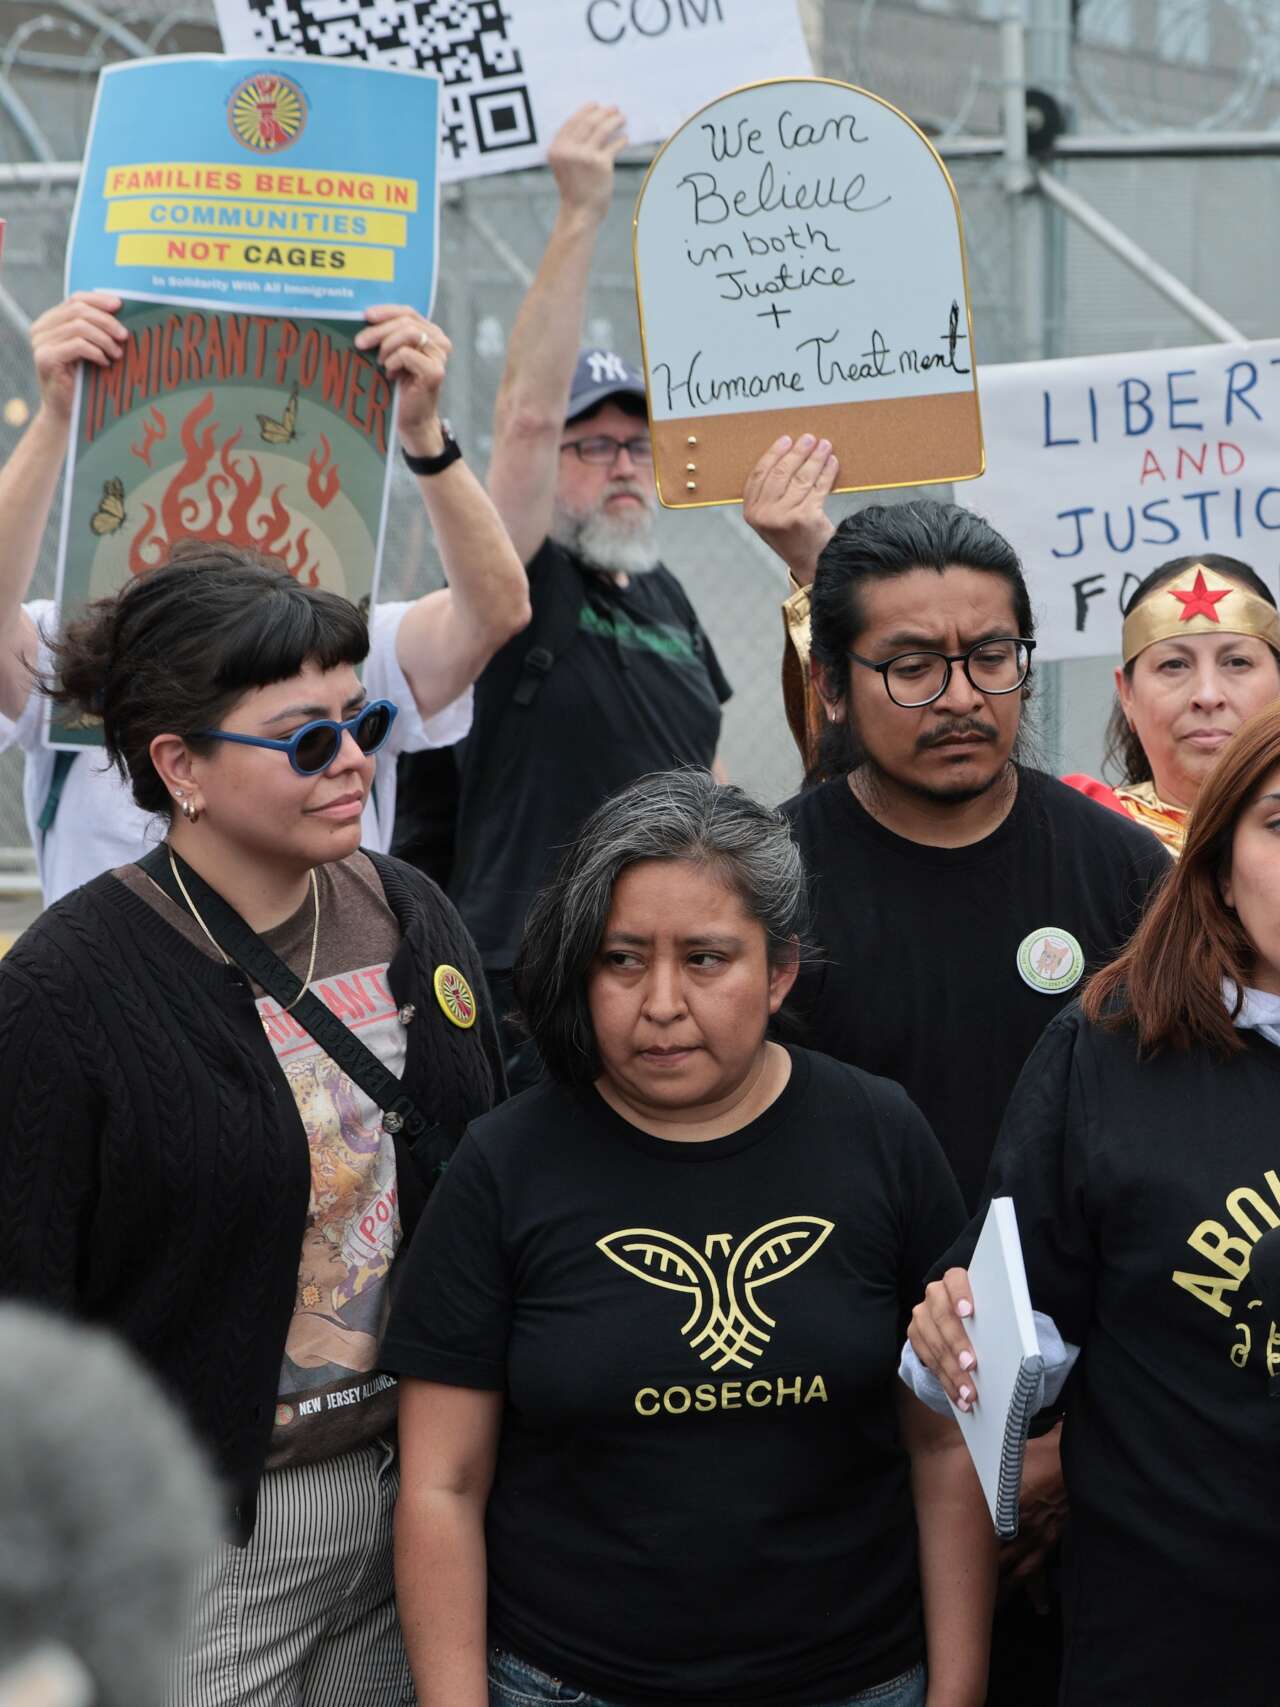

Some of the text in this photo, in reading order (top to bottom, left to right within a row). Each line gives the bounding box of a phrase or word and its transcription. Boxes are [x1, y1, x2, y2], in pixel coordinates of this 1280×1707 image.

[701, 110, 870, 162] We Can
[113, 169, 409, 205] FAMILIES BELONG IN
[676, 161, 893, 225] Believe
[150, 204, 368, 236] COMMUNITIES
[167, 240, 347, 269] NOT CAGES
[685, 224, 841, 267] in both
[152, 274, 355, 299] In Solidarity With All Immigrants
[715, 255, 856, 300] Justice
[756, 303, 792, 329] +
[652, 299, 970, 411] Humane Treatment
[86, 312, 393, 453] IMMIGRANT POWER
[1140, 442, 1246, 484] AND
[299, 1396, 322, 1416] NEW
[326, 1386, 361, 1410] JERSEY
[634, 1374, 829, 1416] COSECHA
